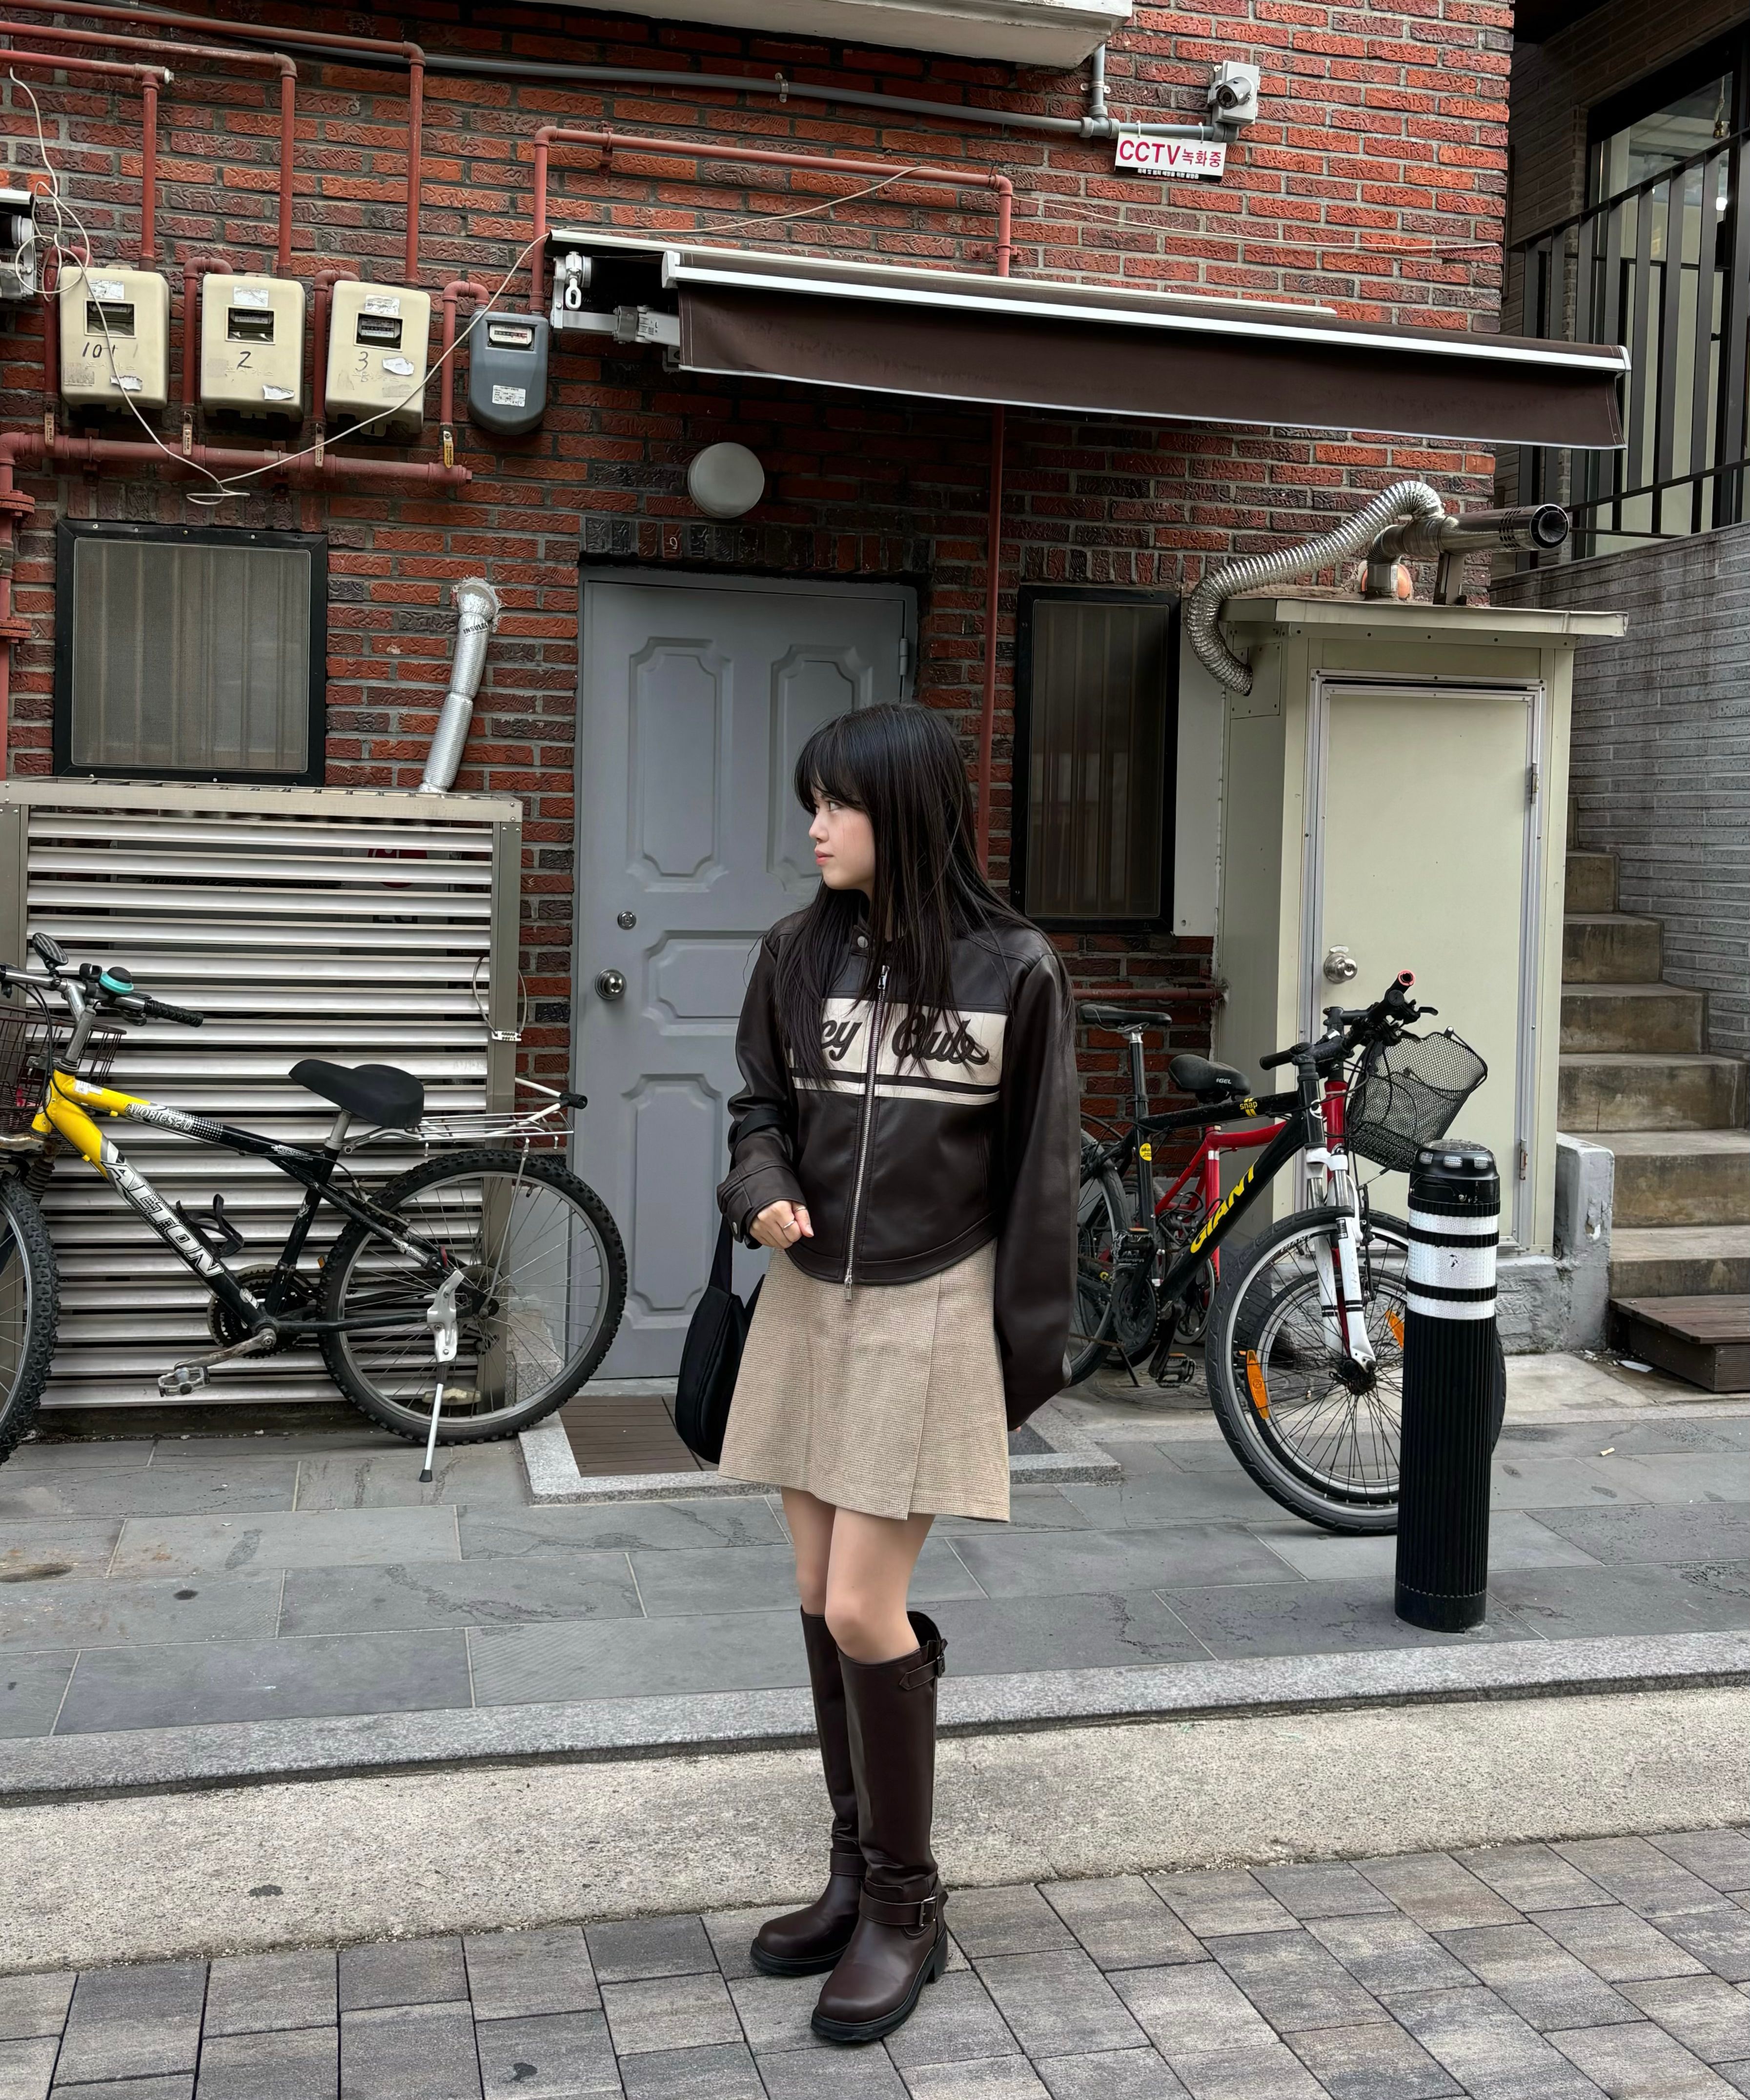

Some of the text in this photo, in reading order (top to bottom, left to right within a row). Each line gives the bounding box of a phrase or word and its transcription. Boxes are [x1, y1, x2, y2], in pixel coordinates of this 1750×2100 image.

[1119, 140, 1221, 168] CCTV 녹화중
[236, 351, 253, 370] 2
[355, 351, 369, 372] 3
[821, 1020, 863, 1061] ey
[1240, 1101, 1258, 1110] snap
[101, 1161, 225, 1277] ALTON
[1190, 1161, 1256, 1254] GIANT
